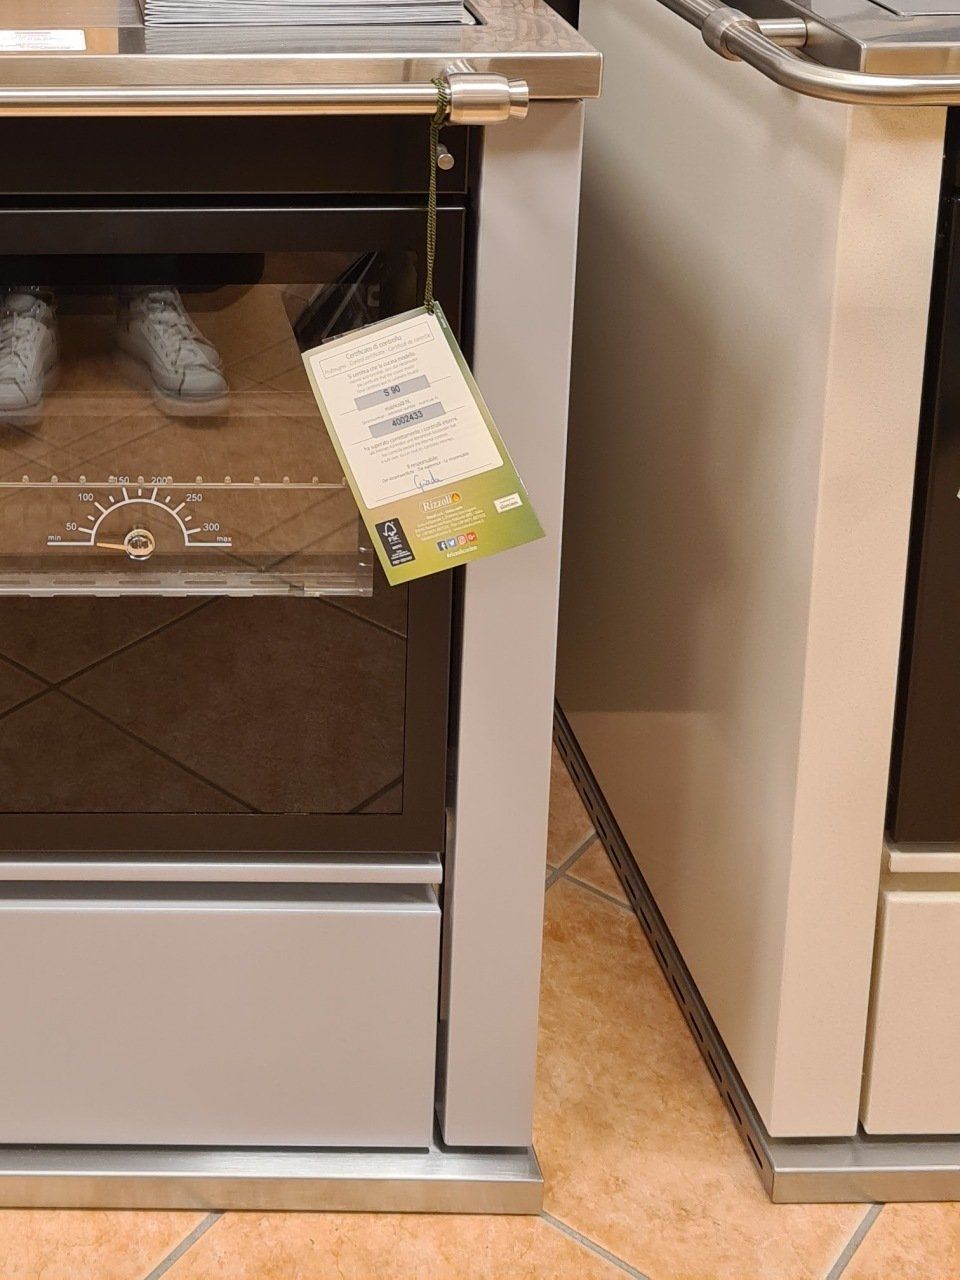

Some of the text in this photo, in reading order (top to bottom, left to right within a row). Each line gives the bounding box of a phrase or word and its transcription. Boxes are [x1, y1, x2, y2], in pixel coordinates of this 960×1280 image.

[390, 384, 400, 394] 90
[391, 410, 423, 427] 4002433
[114, 476, 167, 485] 150 200
[78, 493, 203, 502] 100 250
[422, 494, 452, 512] Rizzoli
[65, 522, 220, 531] 50 300
[47, 534, 62, 542] min
